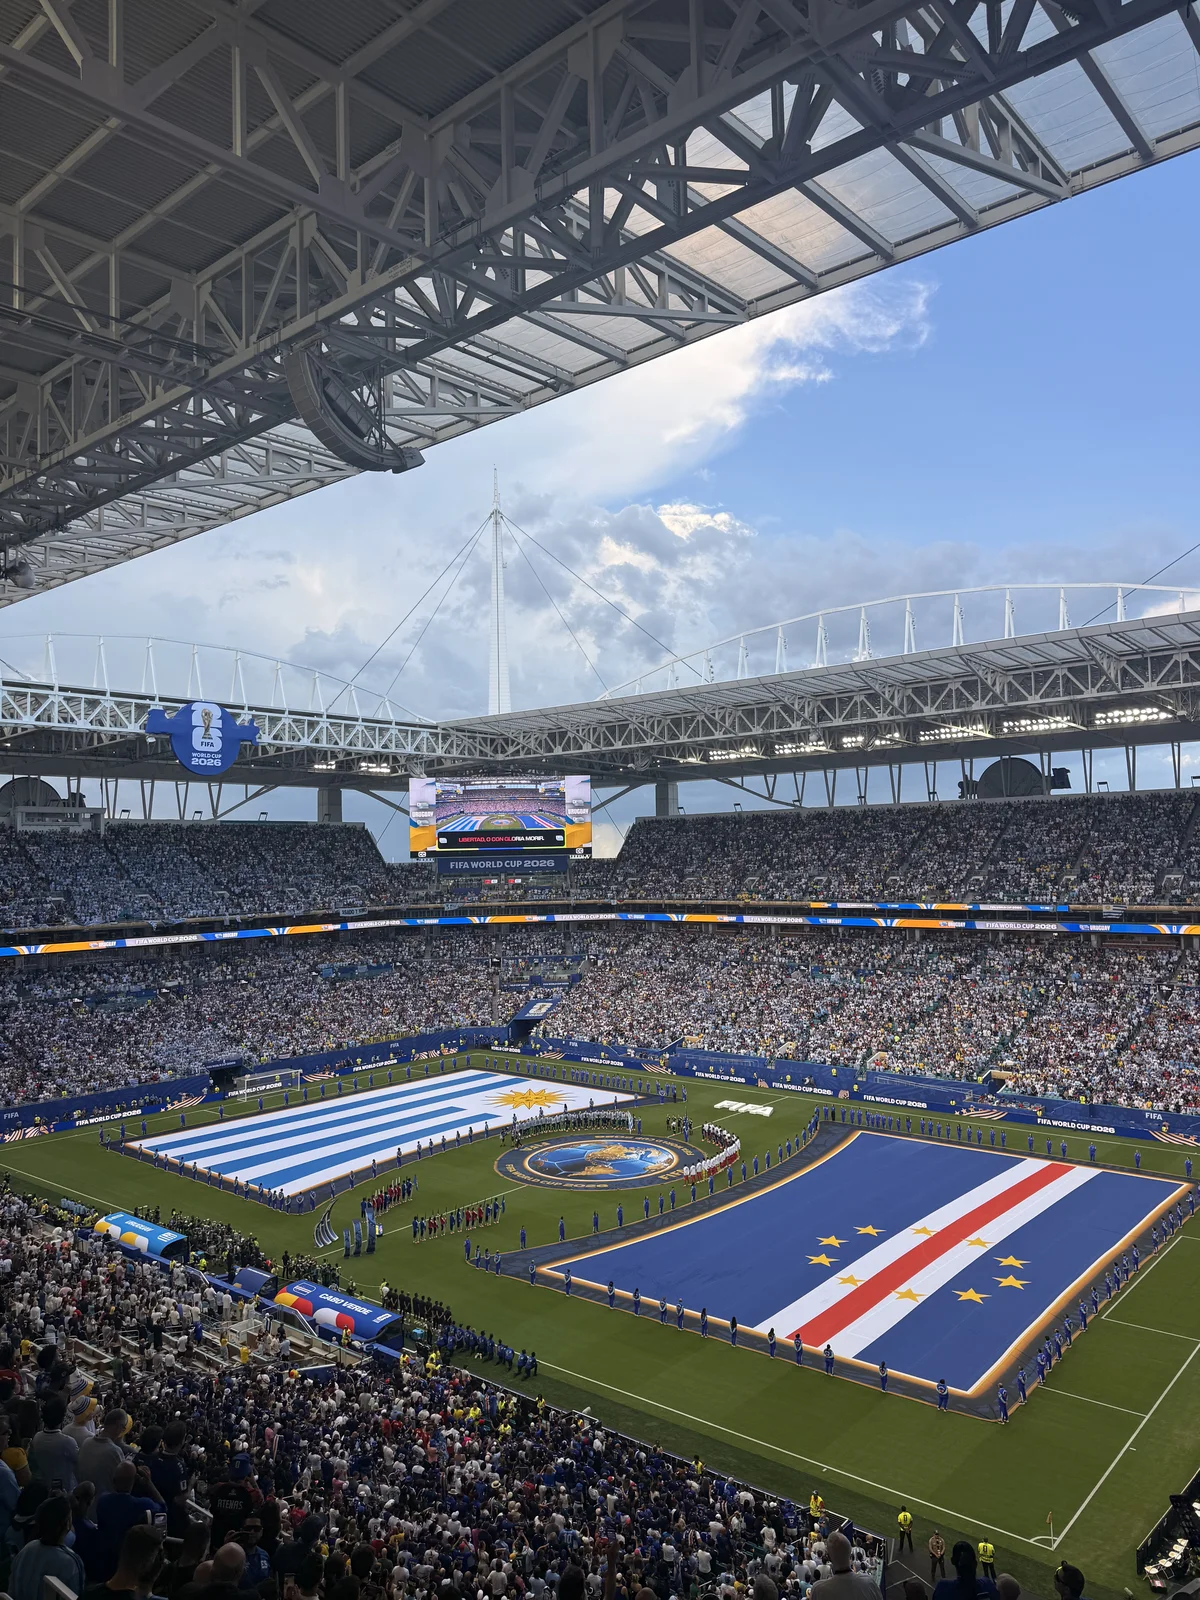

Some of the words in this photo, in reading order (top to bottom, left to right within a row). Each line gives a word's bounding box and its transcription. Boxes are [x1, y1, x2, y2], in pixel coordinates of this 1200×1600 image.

[191, 758, 222, 766] 2026
[524, 859, 555, 867] 2026
[714, 1100, 773, 1117] FIFA
[89, 1115, 109, 1124] WORLD
[122, 1109, 142, 1117] 2026
[1052, 1120, 1076, 1128] WORLD
[1091, 1125, 1115, 1134] 2026
[512, 1172, 540, 1182] WORLD
[125, 1220, 154, 1232] URUGUAY
[319, 1293, 342, 1304] CABO
[342, 1301, 373, 1315] VERDE
[218, 1499, 243, 1510] ATENAS
